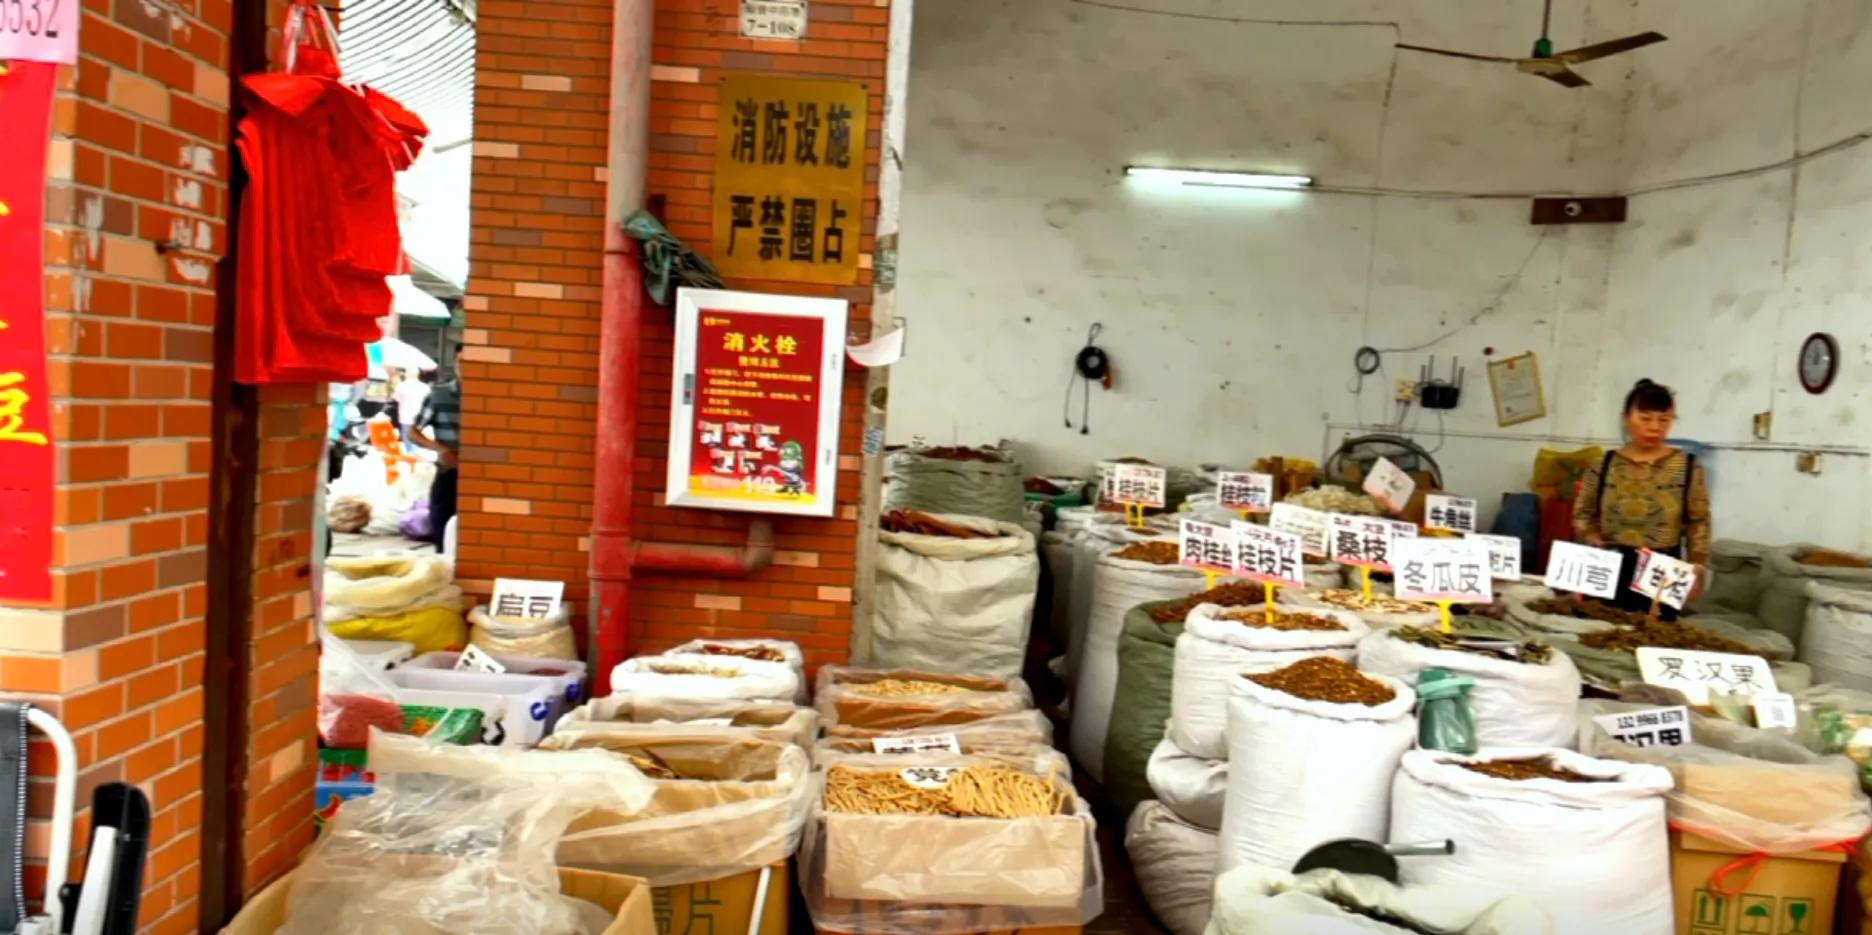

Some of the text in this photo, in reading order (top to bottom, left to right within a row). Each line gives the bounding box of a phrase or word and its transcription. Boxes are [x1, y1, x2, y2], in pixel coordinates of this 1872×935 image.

[732, 98, 852, 168] 消防设施
[727, 194, 847, 263] 严禁圈占
[722, 332, 797, 355] 消火栓
[1238, 541, 1297, 582] 桂枝片
[1337, 530, 1388, 565] 桑枝
[1403, 560, 1482, 594] 冬瓜皮
[1657, 657, 1764, 695] 罗汉果
